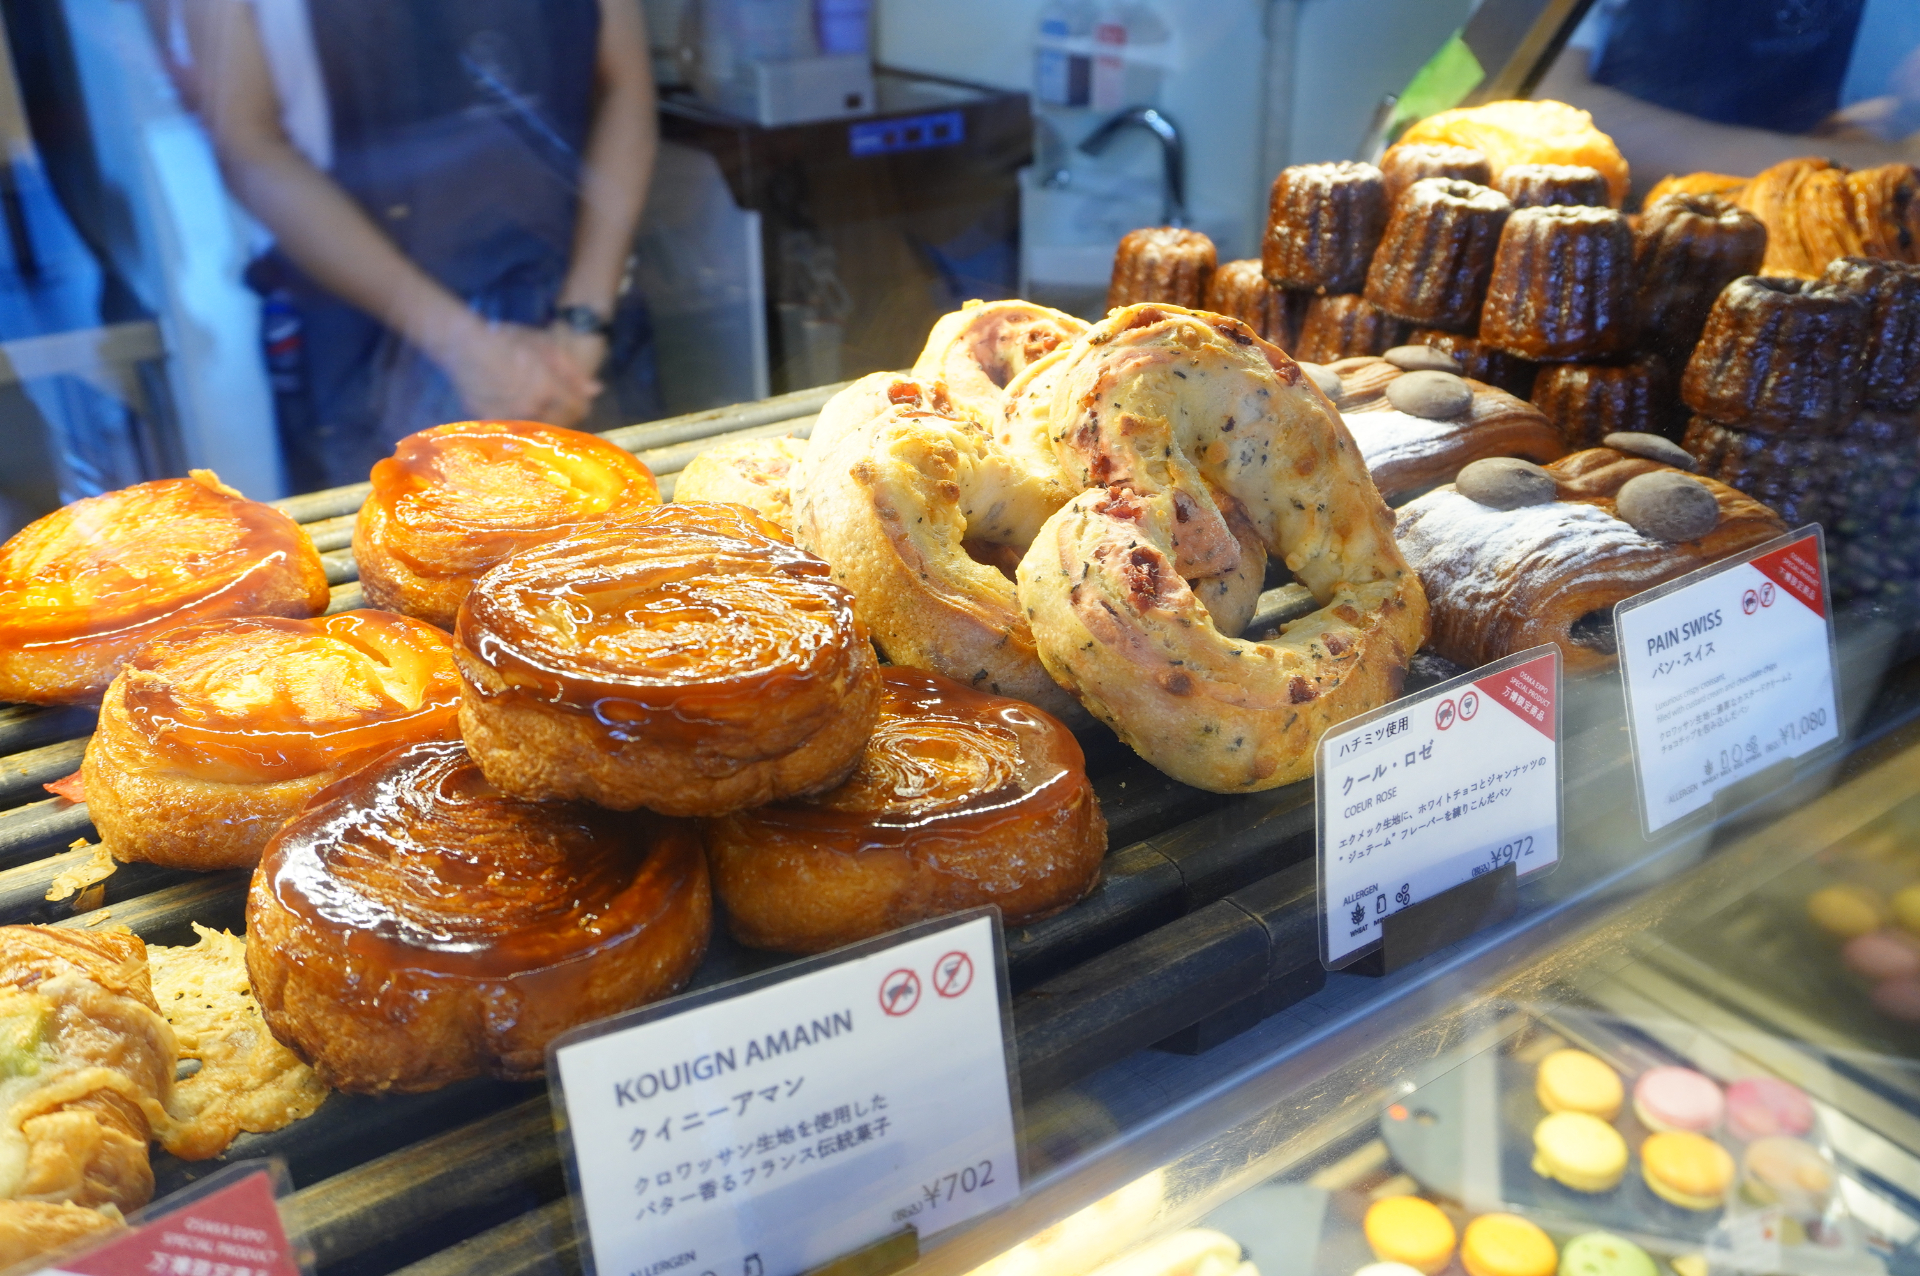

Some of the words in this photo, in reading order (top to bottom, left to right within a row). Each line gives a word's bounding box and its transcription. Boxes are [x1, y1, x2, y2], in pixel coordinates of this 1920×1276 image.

[1647, 627, 1680, 657] PAIN
[1682, 608, 1723, 641] SWISS
[1652, 641, 1716, 679] パン・スイス
[1510, 676, 1529, 694] SPECIAL
[1527, 688, 1551, 707] PRODUCT
[1519, 670, 1536, 687] OSAKA
[1534, 681, 1549, 695] EXPO
[1501, 685, 1545, 722] 万博限定商品
[1339, 715, 1409, 758] ハチミツ使用
[1779, 707, 1827, 747] ¥1,080
[1342, 738, 1435, 797] クール・ロゼ
[1344, 797, 1373, 819] COEUR
[1375, 786, 1397, 805] ROSE
[1490, 835, 1534, 870] ¥972
[1342, 883, 1379, 908] ALLERGEN
[1349, 923, 1369, 938] WHEAT
[614, 1047, 736, 1108] KOUIGN
[744, 1009, 853, 1067] AMANN
[629, 1076, 805, 1152] クイニーアマン
[635, 1094, 888, 1196] クロワッサン生地を使用した
[922, 1159, 996, 1210] ¥702
